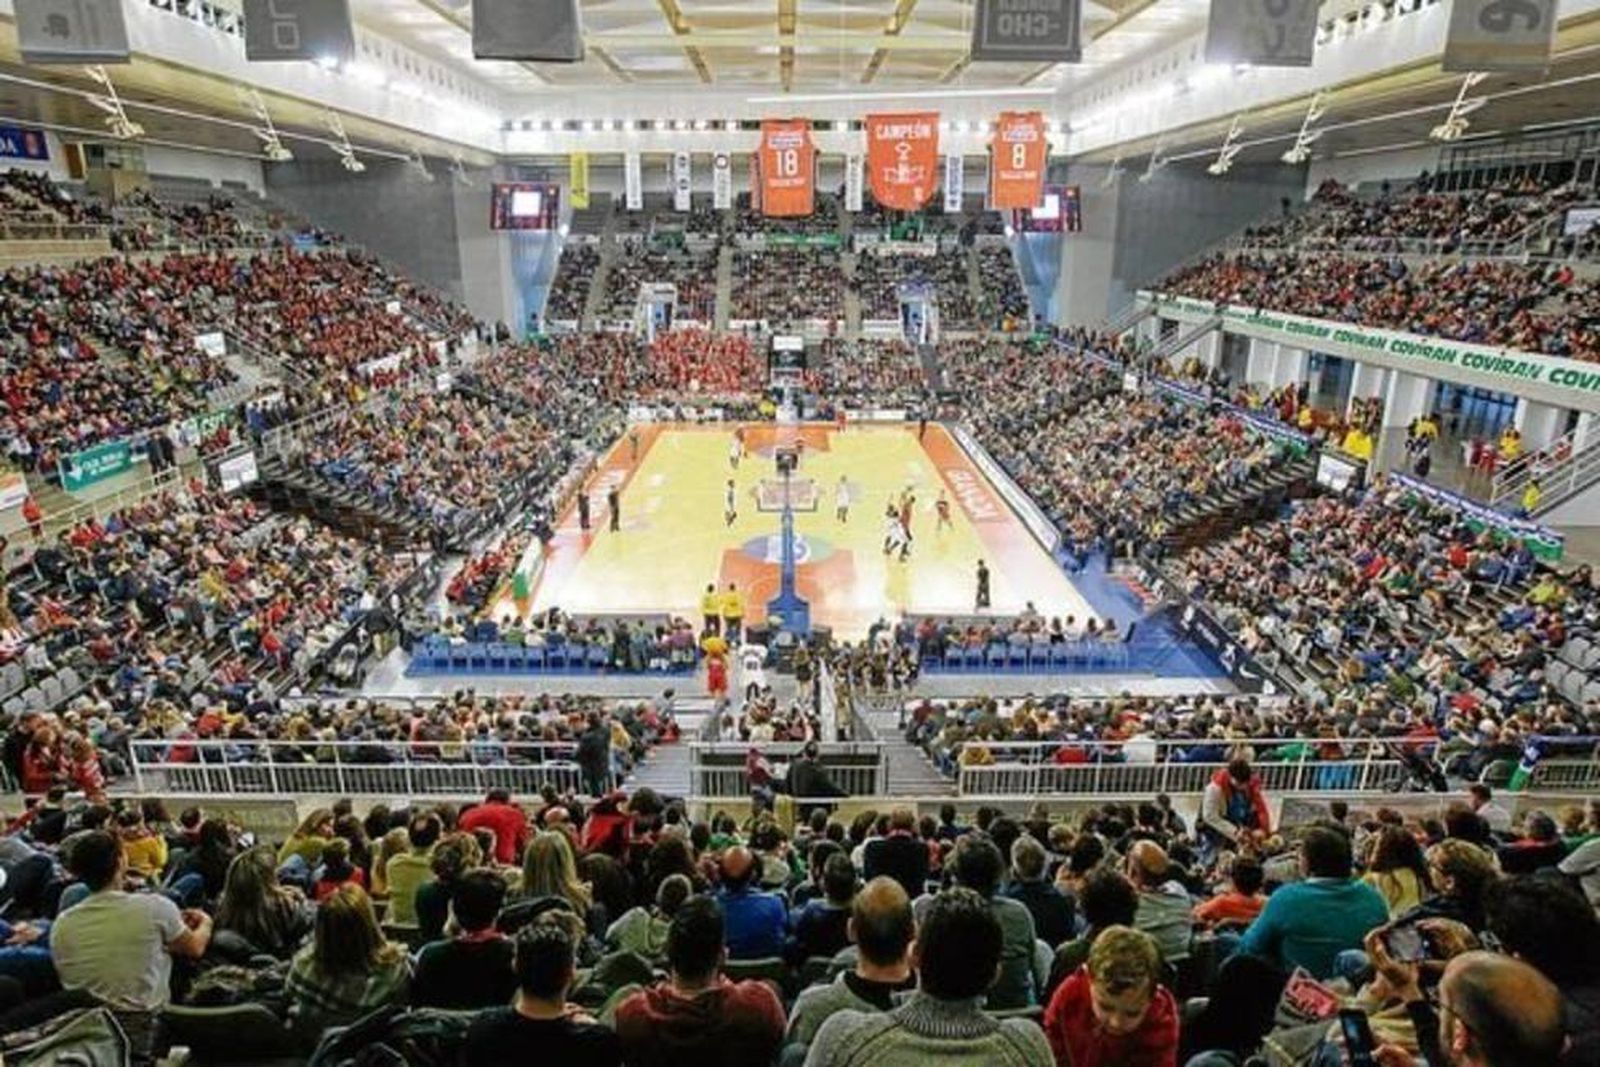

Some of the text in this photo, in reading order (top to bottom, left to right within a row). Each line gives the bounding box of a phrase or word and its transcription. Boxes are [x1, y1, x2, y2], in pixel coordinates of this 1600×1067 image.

[776, 149, 798, 177] 18
[1012, 143, 1025, 169] 8
[1333, 329, 1388, 348] COVIRAN
[1391, 339, 1457, 363] COVIRAN
[1461, 351, 1544, 378] COVIRAN
